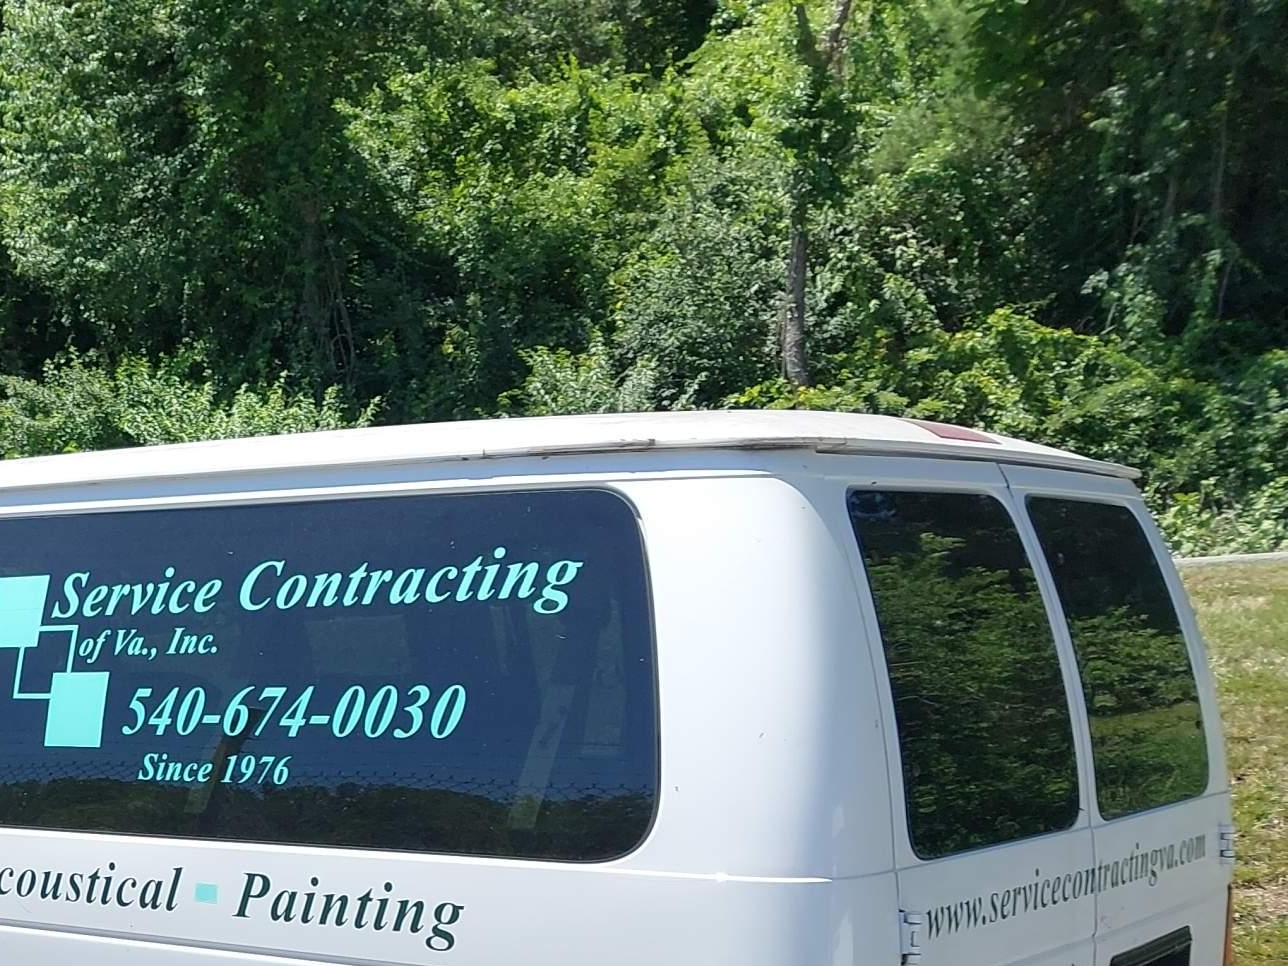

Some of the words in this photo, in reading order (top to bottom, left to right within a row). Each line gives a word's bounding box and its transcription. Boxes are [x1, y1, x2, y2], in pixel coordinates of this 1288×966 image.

[51, 566, 222, 619] Service
[239, 546, 584, 615] Contracting
[78, 629, 110, 664] of
[114, 629, 157, 661] Va.,
[166, 627, 218, 656] Inc.
[121, 684, 466, 739] 540-674-0030
[137, 753, 213, 783] Since
[221, 755, 292, 785] 1976
[231, 872, 465, 952] Painting
[926, 834, 1206, 941] www.servicecontractingva.com
